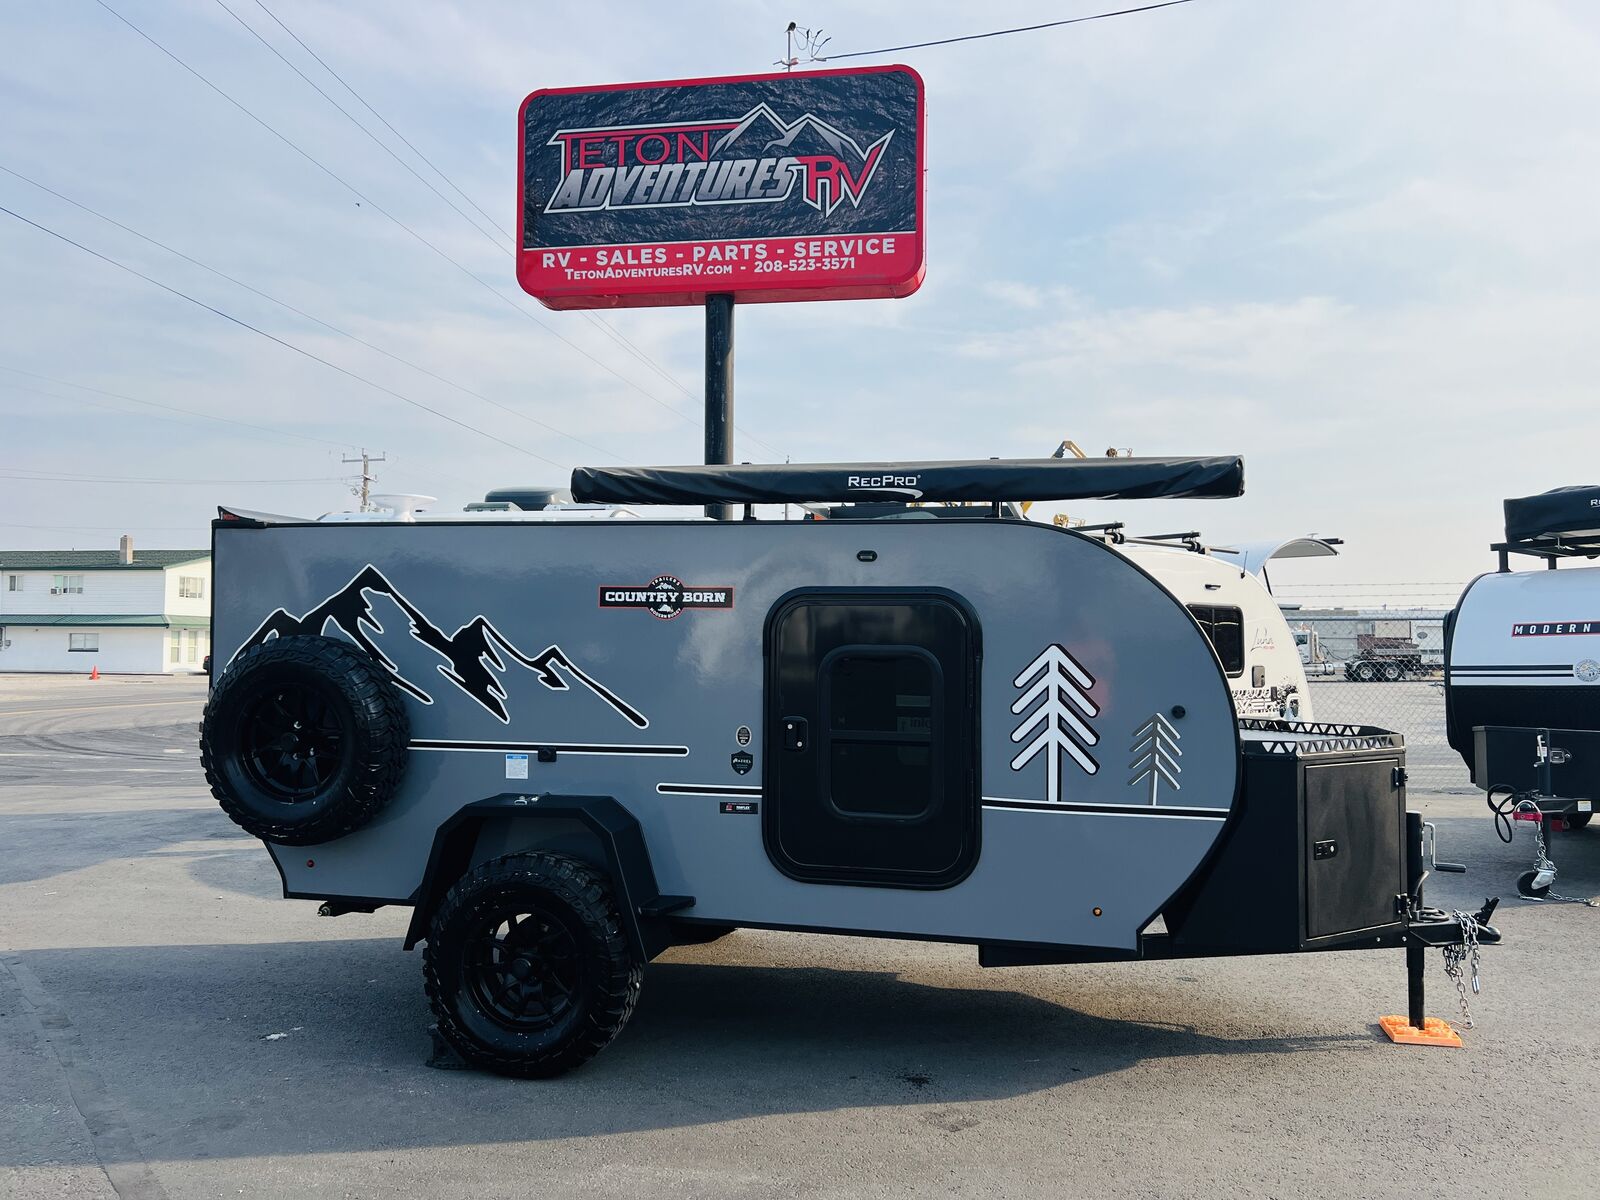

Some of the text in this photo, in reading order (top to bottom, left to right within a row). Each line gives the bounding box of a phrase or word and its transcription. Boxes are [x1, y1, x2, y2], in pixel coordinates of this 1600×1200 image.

[557, 129, 710, 176] TETON
[551, 145, 882, 208] ADVENTURES RV
[542, 252, 572, 268] RV
[596, 247, 667, 266] SALES
[693, 243, 768, 262] PARTS
[794, 238, 895, 258] SERVICE
[564, 263, 732, 280] TETONADVENTURESRV.COM
[754, 257, 855, 272] 208-523-3571
[848, 475, 917, 487] RECPRO
[605, 591, 726, 603] COUNTRY BORN
[1514, 623, 1592, 635] MODERN
